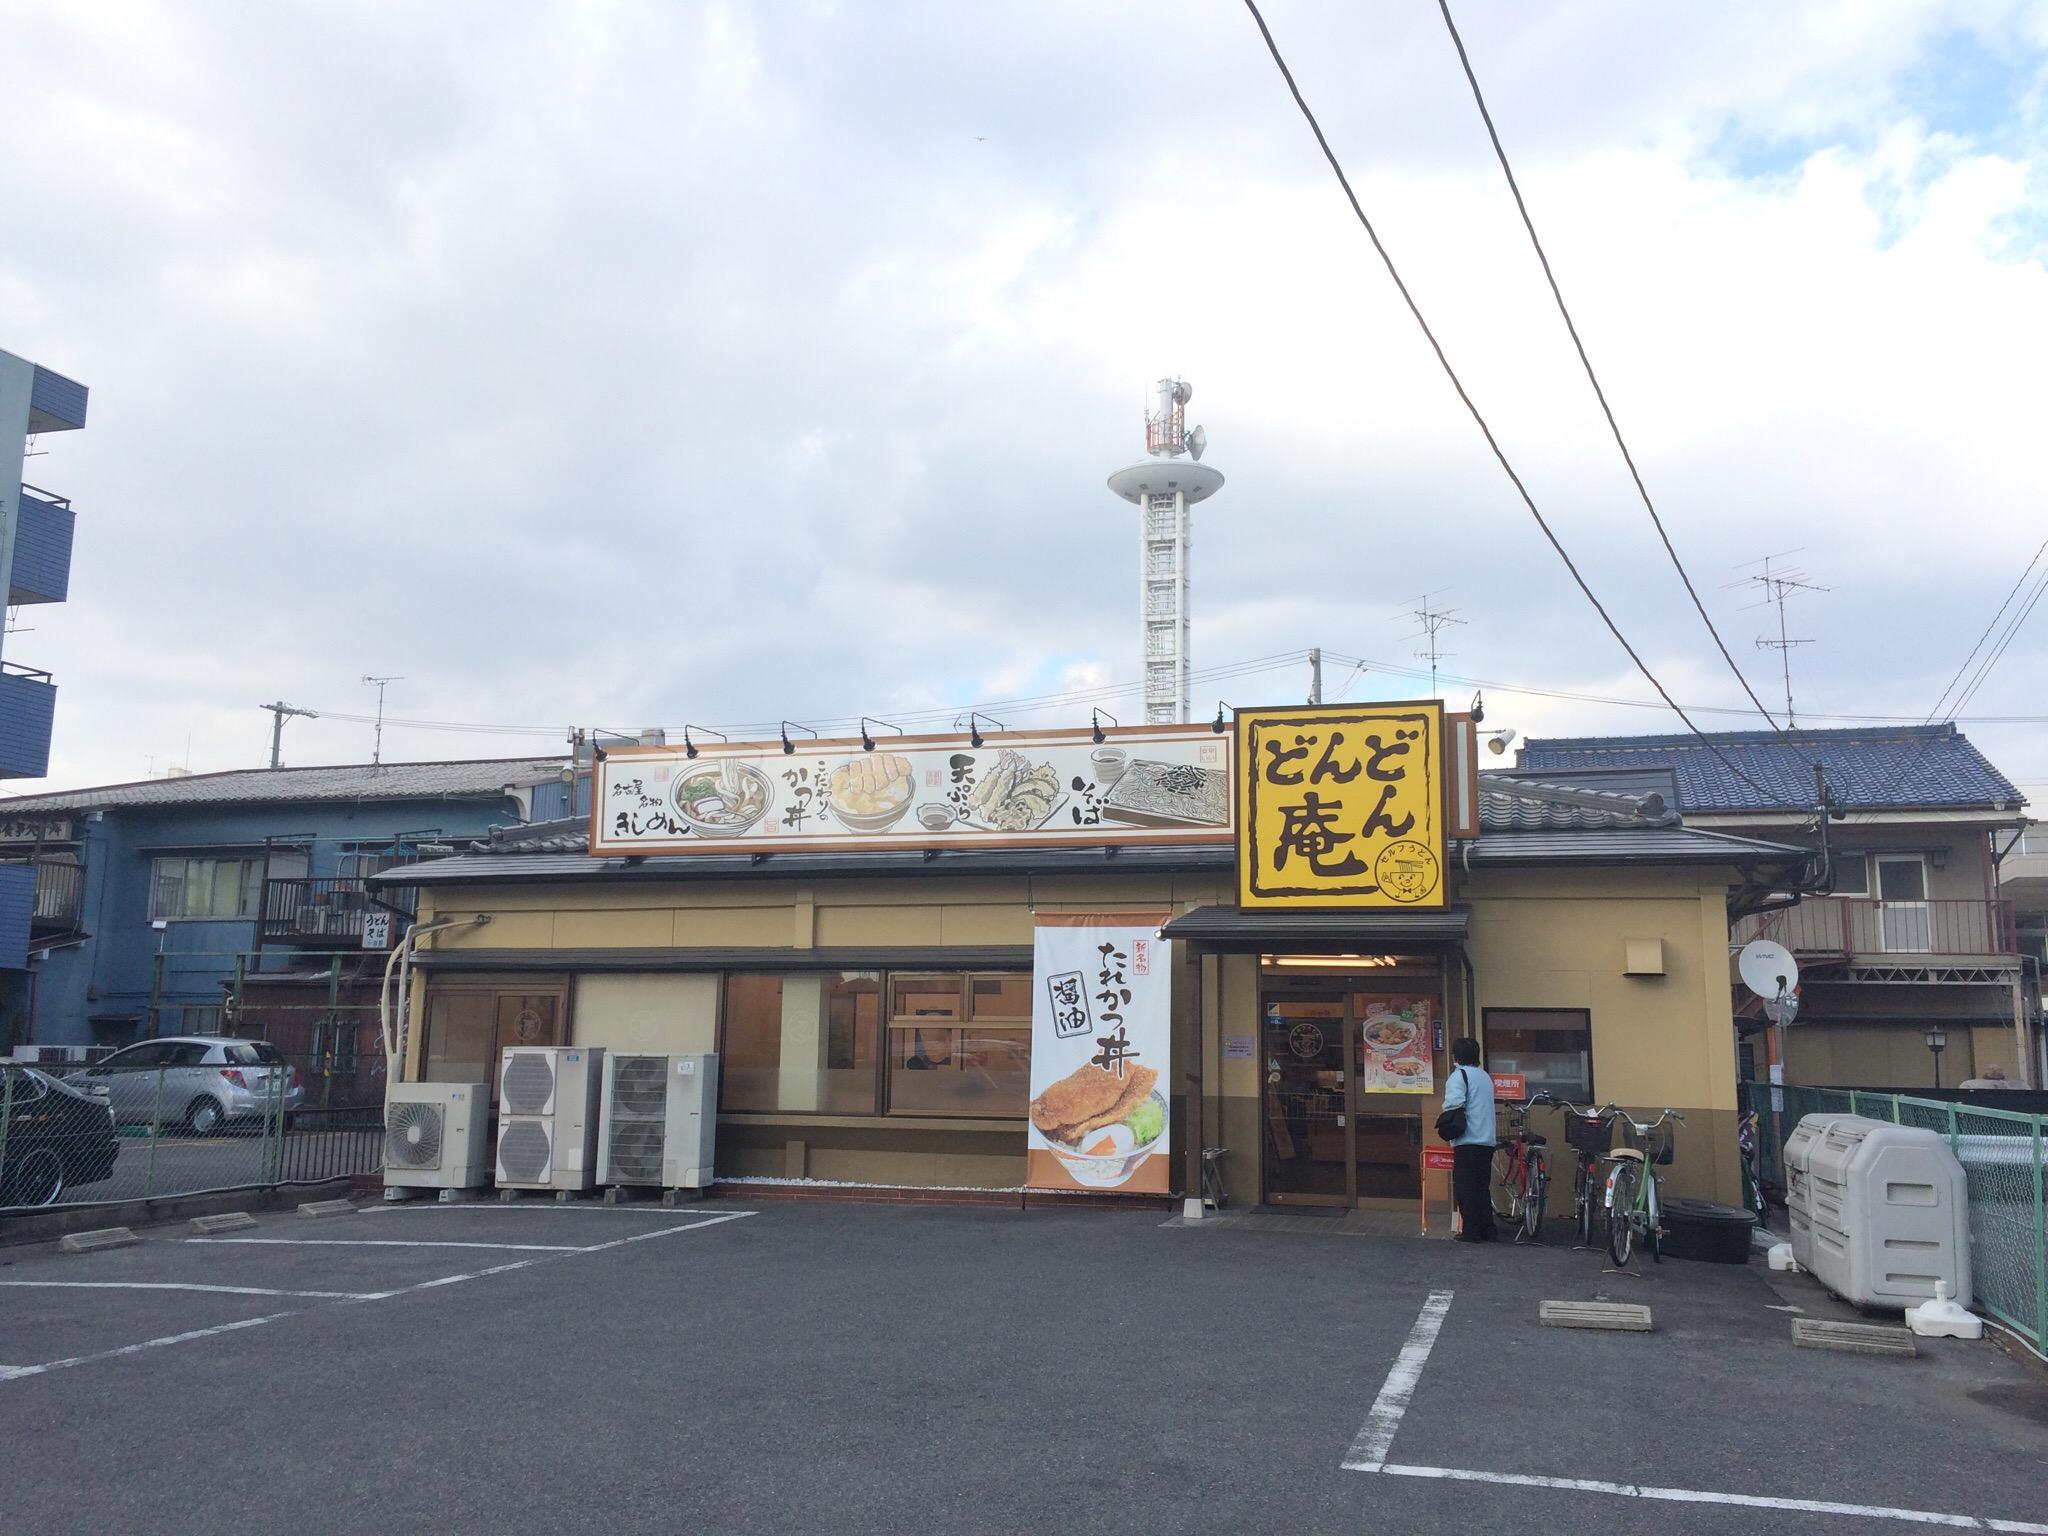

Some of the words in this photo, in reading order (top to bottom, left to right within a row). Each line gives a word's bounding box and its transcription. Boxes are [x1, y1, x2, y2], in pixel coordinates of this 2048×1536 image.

[612, 779, 643, 797] 名古屋
[781, 767, 812, 832] かつ丼
[814, 760, 833, 821] こだわりの
[946, 753, 976, 820] 天ぷら
[1071, 775, 1110, 826] そば
[614, 811, 691, 837] きしめん
[1380, 844, 1433, 865] セルフうどん
[366, 914, 389, 927] うどん
[367, 928, 386, 939] そば
[1091, 942, 1140, 1078] たれかつ丼
